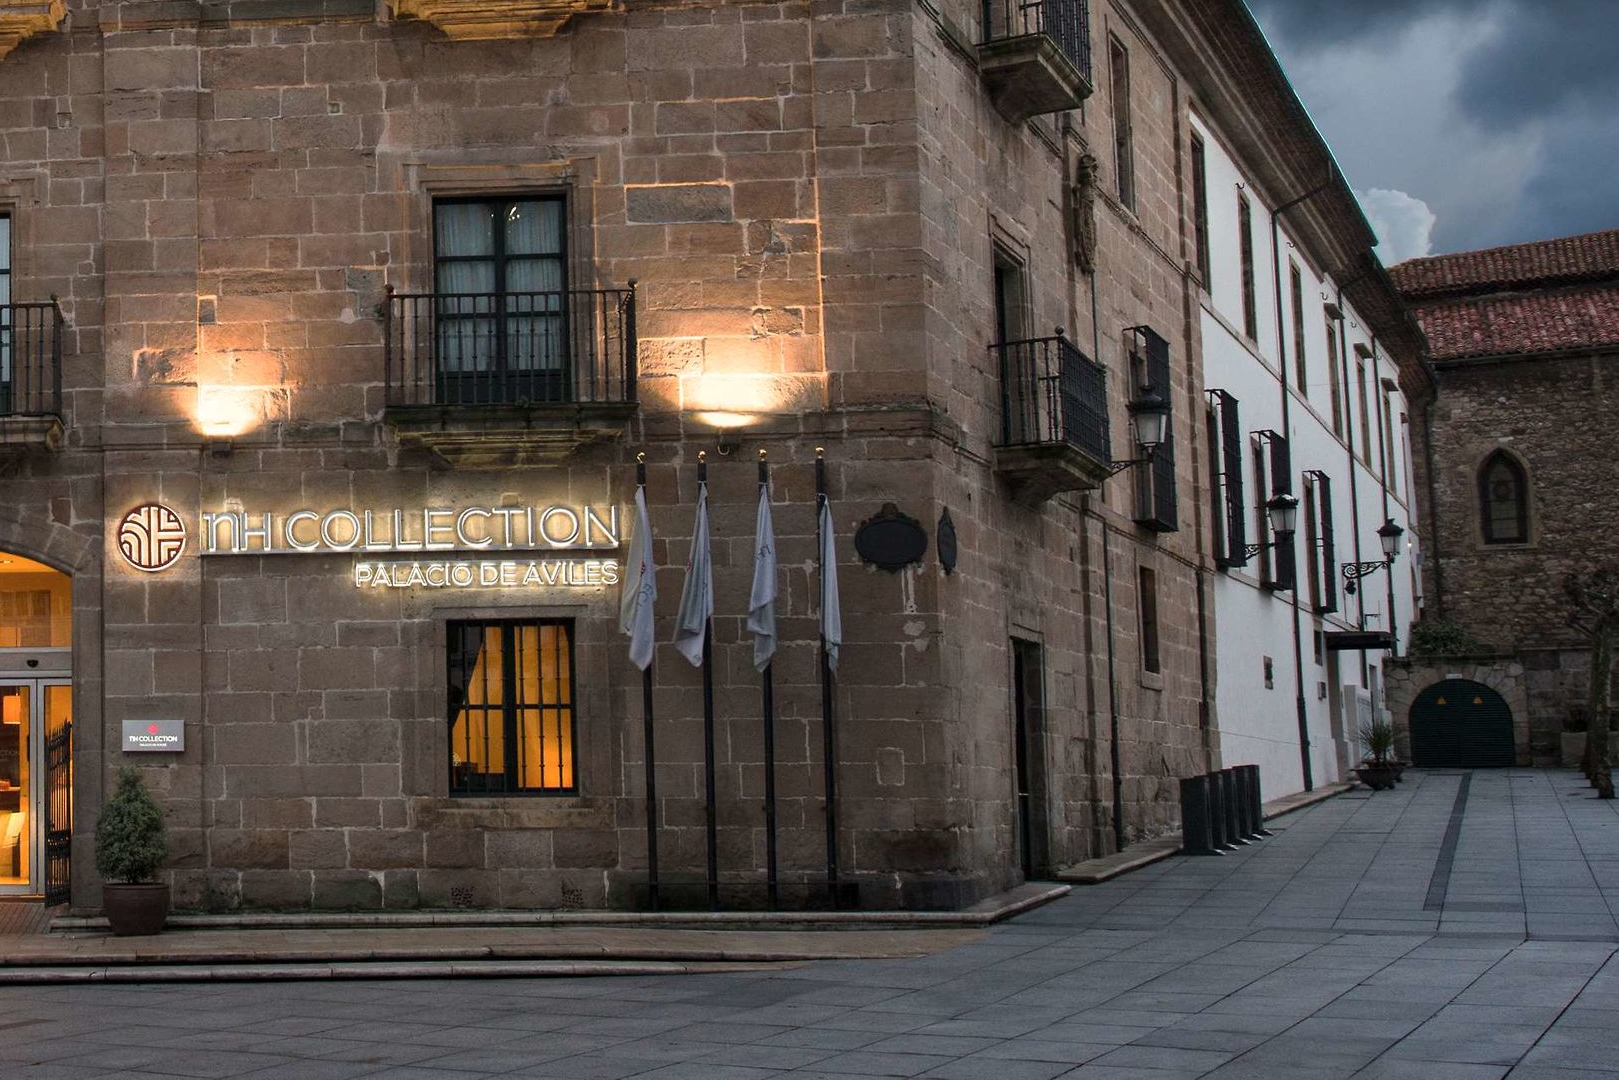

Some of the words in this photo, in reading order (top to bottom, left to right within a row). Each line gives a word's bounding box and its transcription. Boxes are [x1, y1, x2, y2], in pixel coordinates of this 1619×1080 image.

[285, 505, 619, 551] COLLECTION
[356, 562, 473, 587] PALACIO
[480, 562, 518, 585] DE
[522, 560, 619, 585] AVILES
